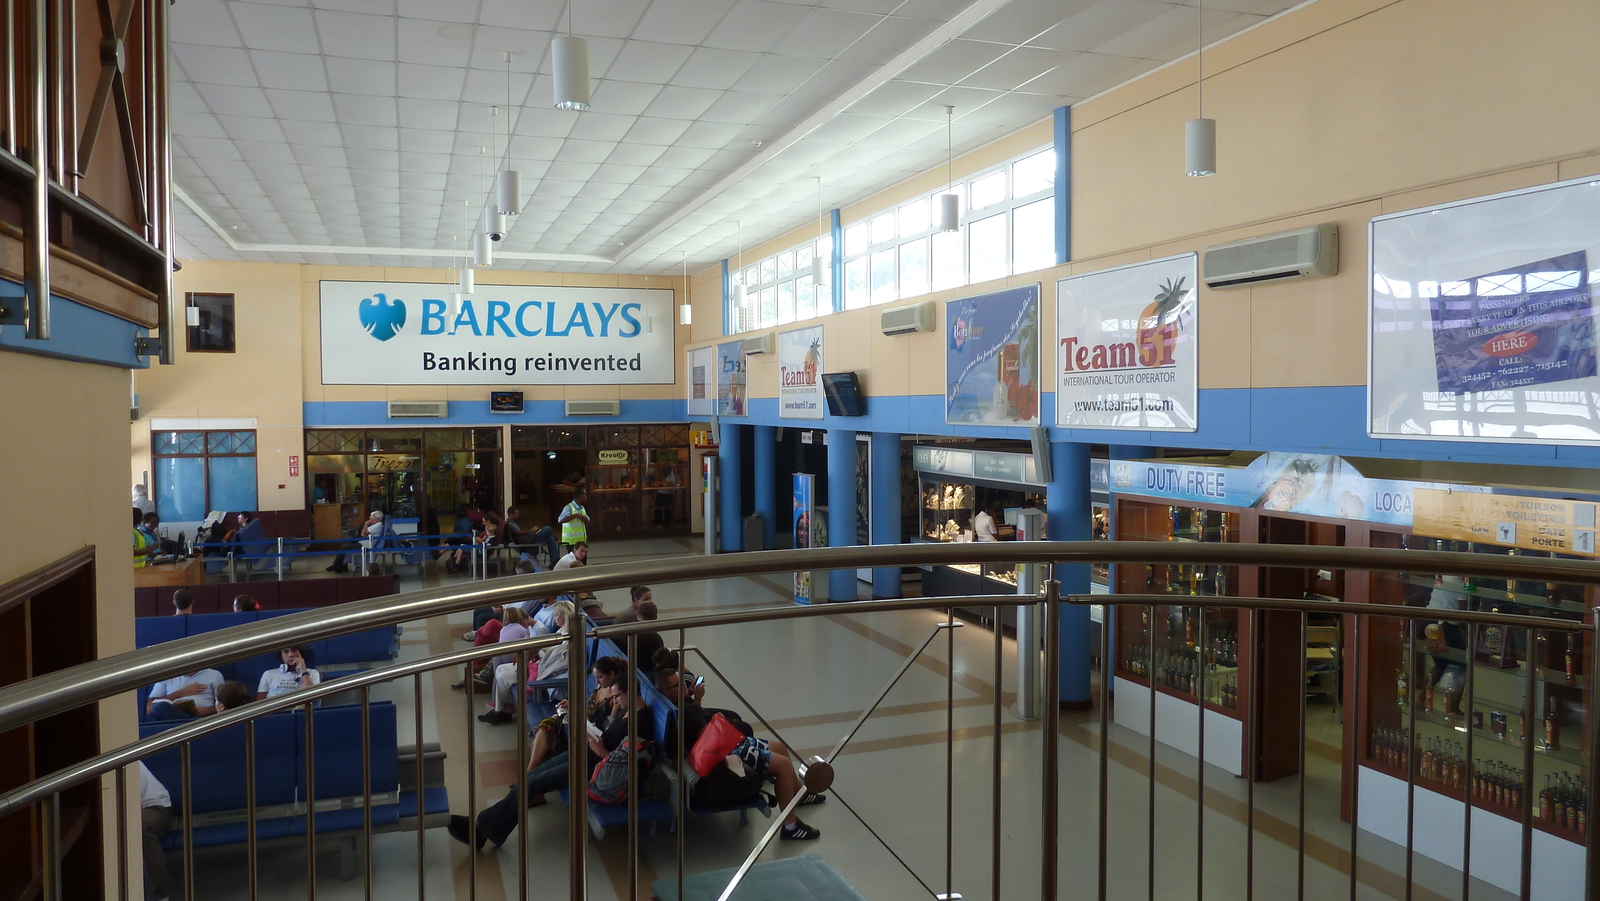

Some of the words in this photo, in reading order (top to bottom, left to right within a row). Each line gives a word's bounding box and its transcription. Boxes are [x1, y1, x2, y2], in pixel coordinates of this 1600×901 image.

[1467, 312, 1493, 326] EVERY
[1493, 308, 1514, 321] YEAR
[1516, 305, 1526, 316] IN
[1526, 301, 1548, 314] THIS
[1550, 292, 1588, 309] AIRPORT
[1479, 294, 1530, 311] PASSENGERS
[420, 299, 642, 338] BARCLAYS
[1466, 326, 1490, 339] YOUR
[1490, 313, 1550, 335] ADVERTISING
[1060, 326, 1176, 372] Team51
[1492, 336, 1527, 354] HERE
[423, 352, 517, 376] Banking
[525, 352, 642, 372] reinvented
[1462, 371, 1491, 383] 324452
[1497, 366, 1529, 378] 762227
[1536, 359, 1568, 373] 715142
[1498, 356, 1522, 366] CALL:
[1063, 374, 1114, 387] INTERNATIONAL
[1114, 374, 1135, 385] TOUR
[1136, 371, 1176, 383] OPERATOR
[1491, 380, 1508, 388] FAX:
[1074, 397, 1174, 412] www.team51.com
[1147, 466, 1183, 493] DUTY
[1187, 470, 1225, 497] FREE
[1531, 536, 1565, 548] PORTE
